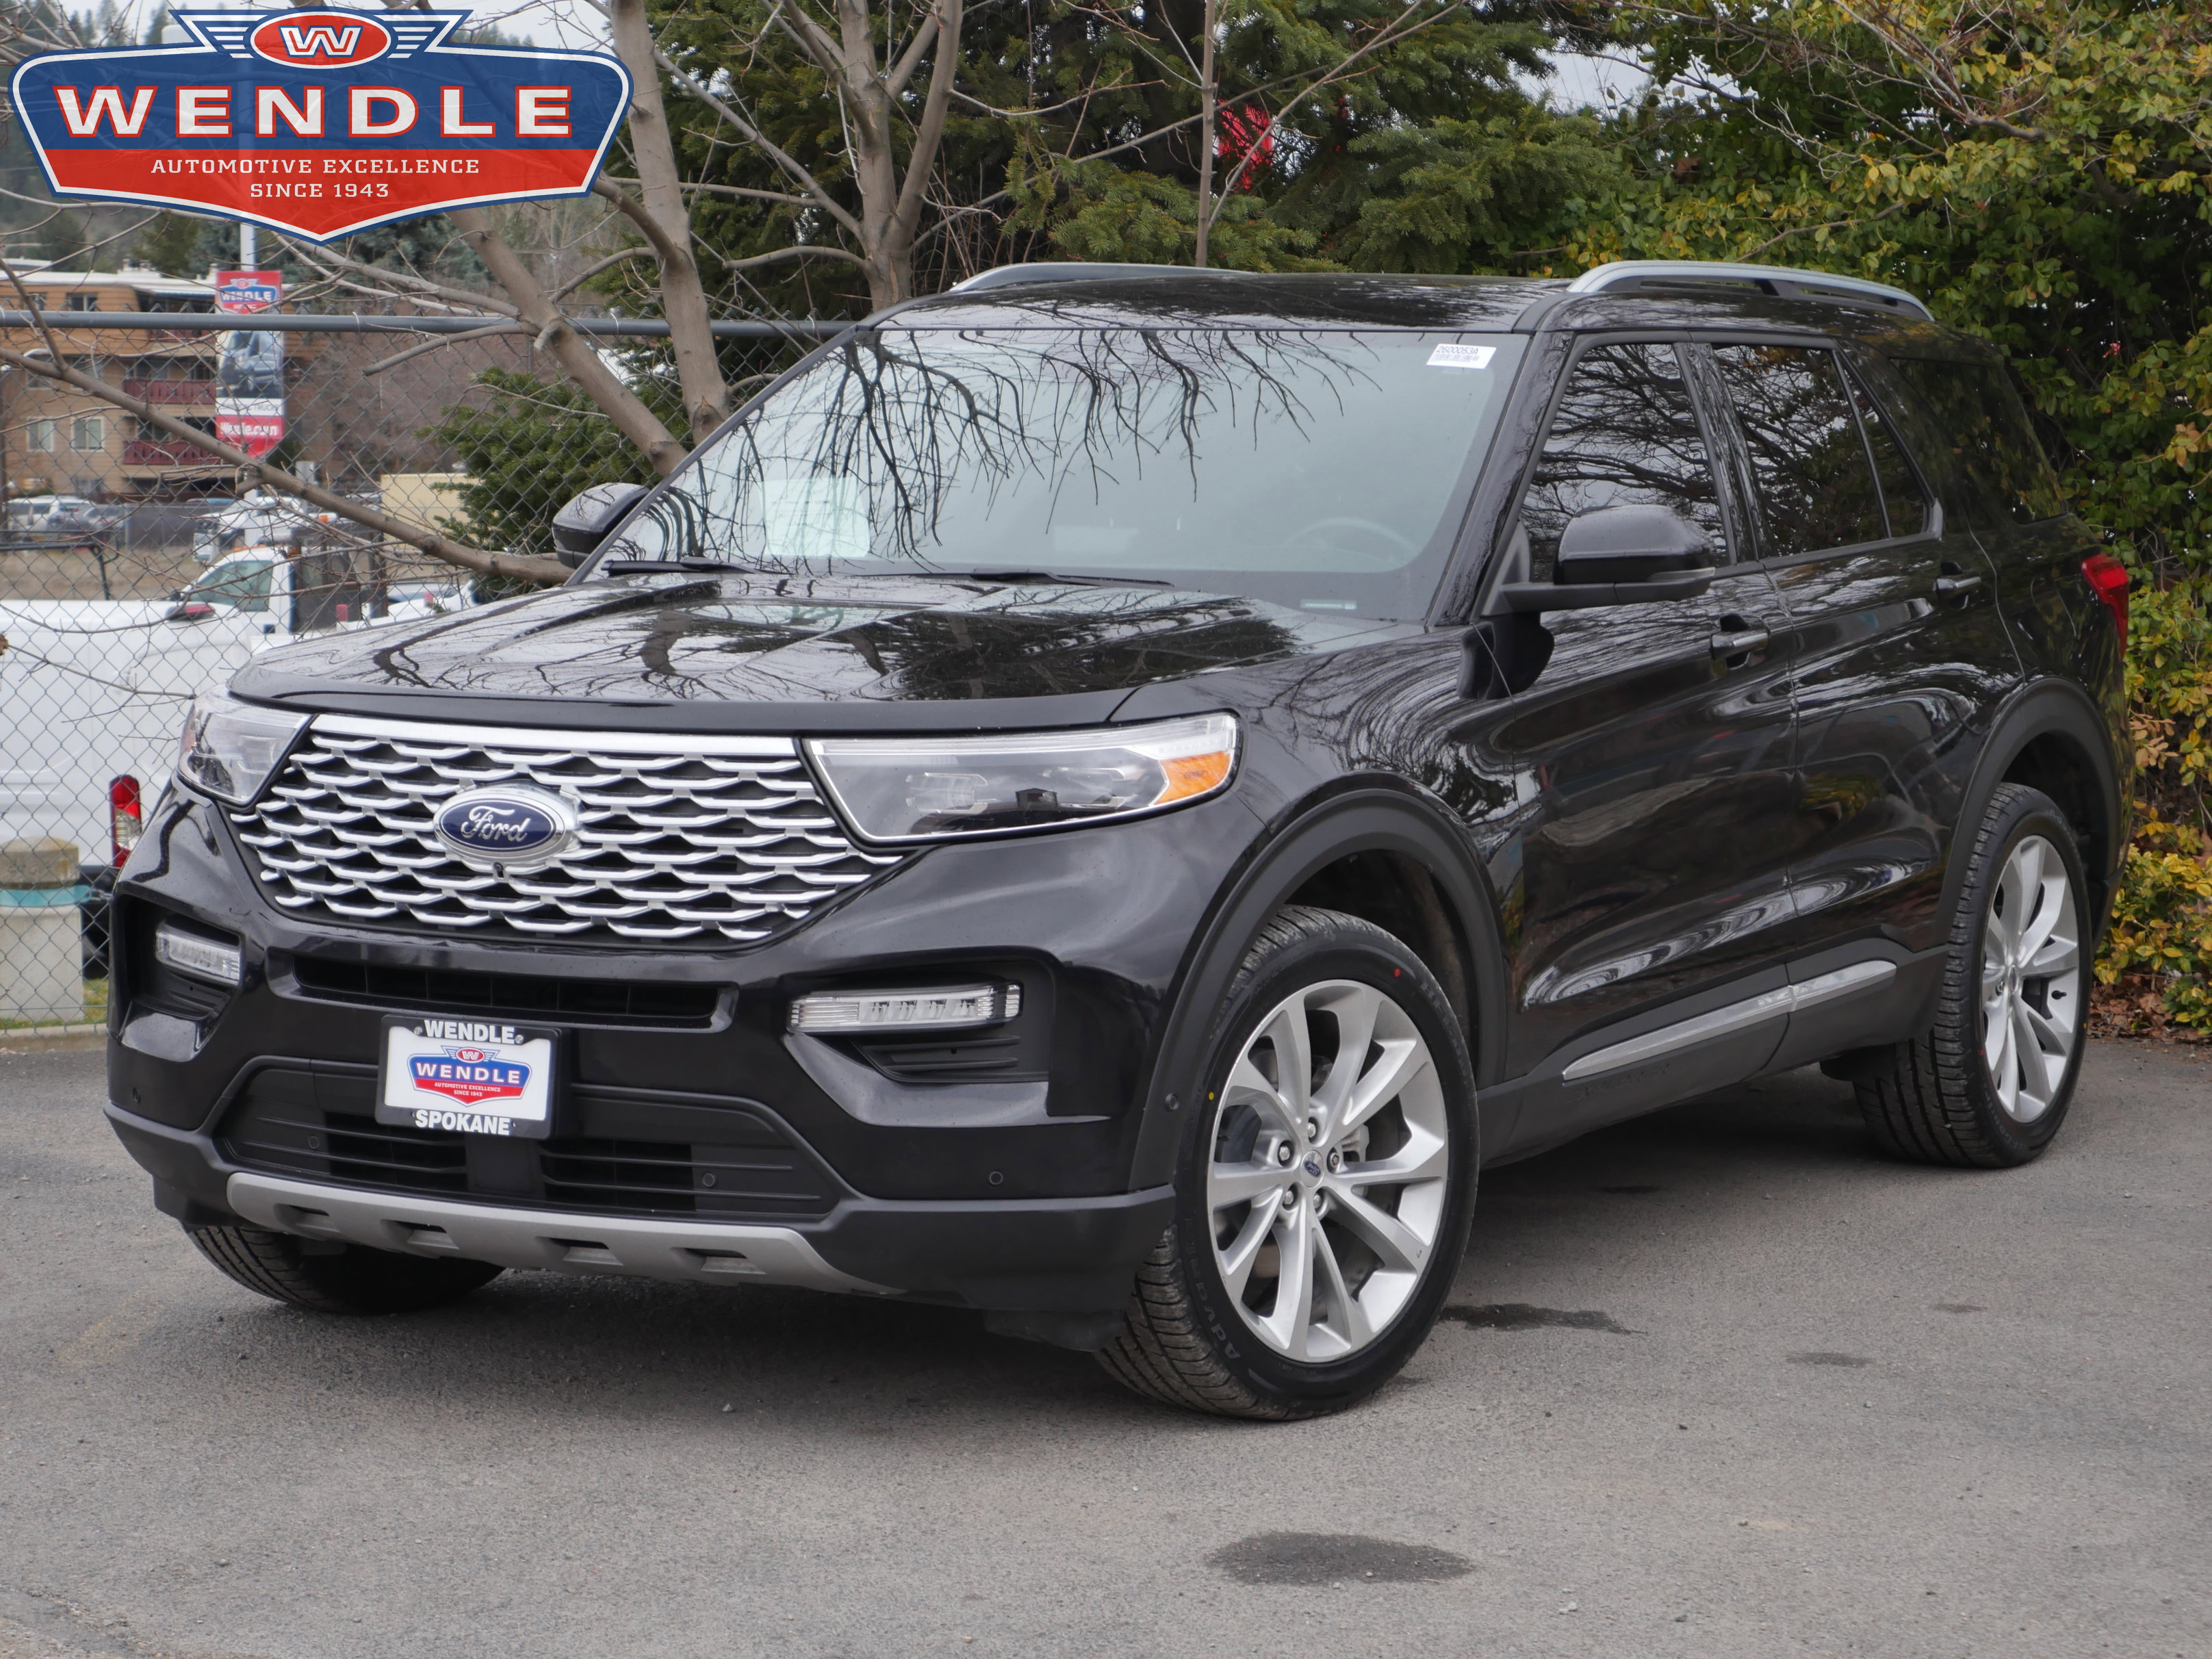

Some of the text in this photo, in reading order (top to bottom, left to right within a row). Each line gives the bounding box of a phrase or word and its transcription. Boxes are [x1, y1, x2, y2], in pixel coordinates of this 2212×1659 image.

[222, 291, 272, 301] WENDLE
[461, 806, 531, 842] Ford
[424, 1019, 515, 1044] WENDLE
[415, 1062, 520, 1084] WENDLE
[434, 1082, 501, 1092] AUTOMOTIVE EXCELLENCE
[415, 1109, 511, 1135] SPOKANE
